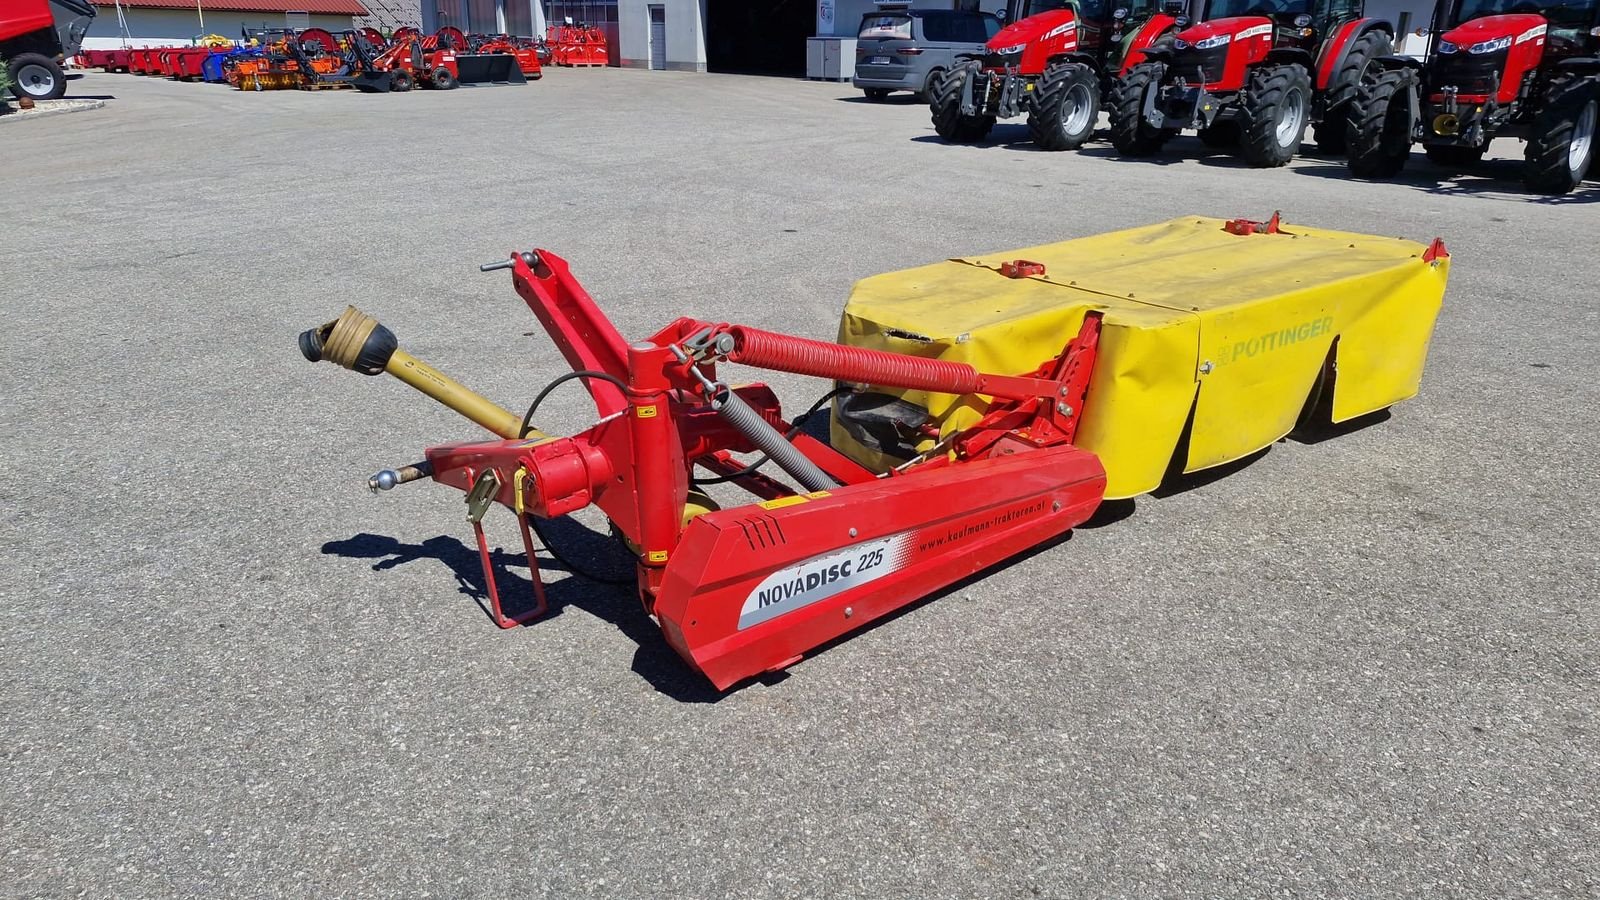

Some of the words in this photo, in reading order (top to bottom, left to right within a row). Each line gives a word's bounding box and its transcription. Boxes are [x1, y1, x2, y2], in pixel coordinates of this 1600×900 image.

[919, 500, 1046, 552] www.kaufmann-traktoren.at
[758, 560, 852, 609] NOVADISC
[856, 548, 885, 573] 225
